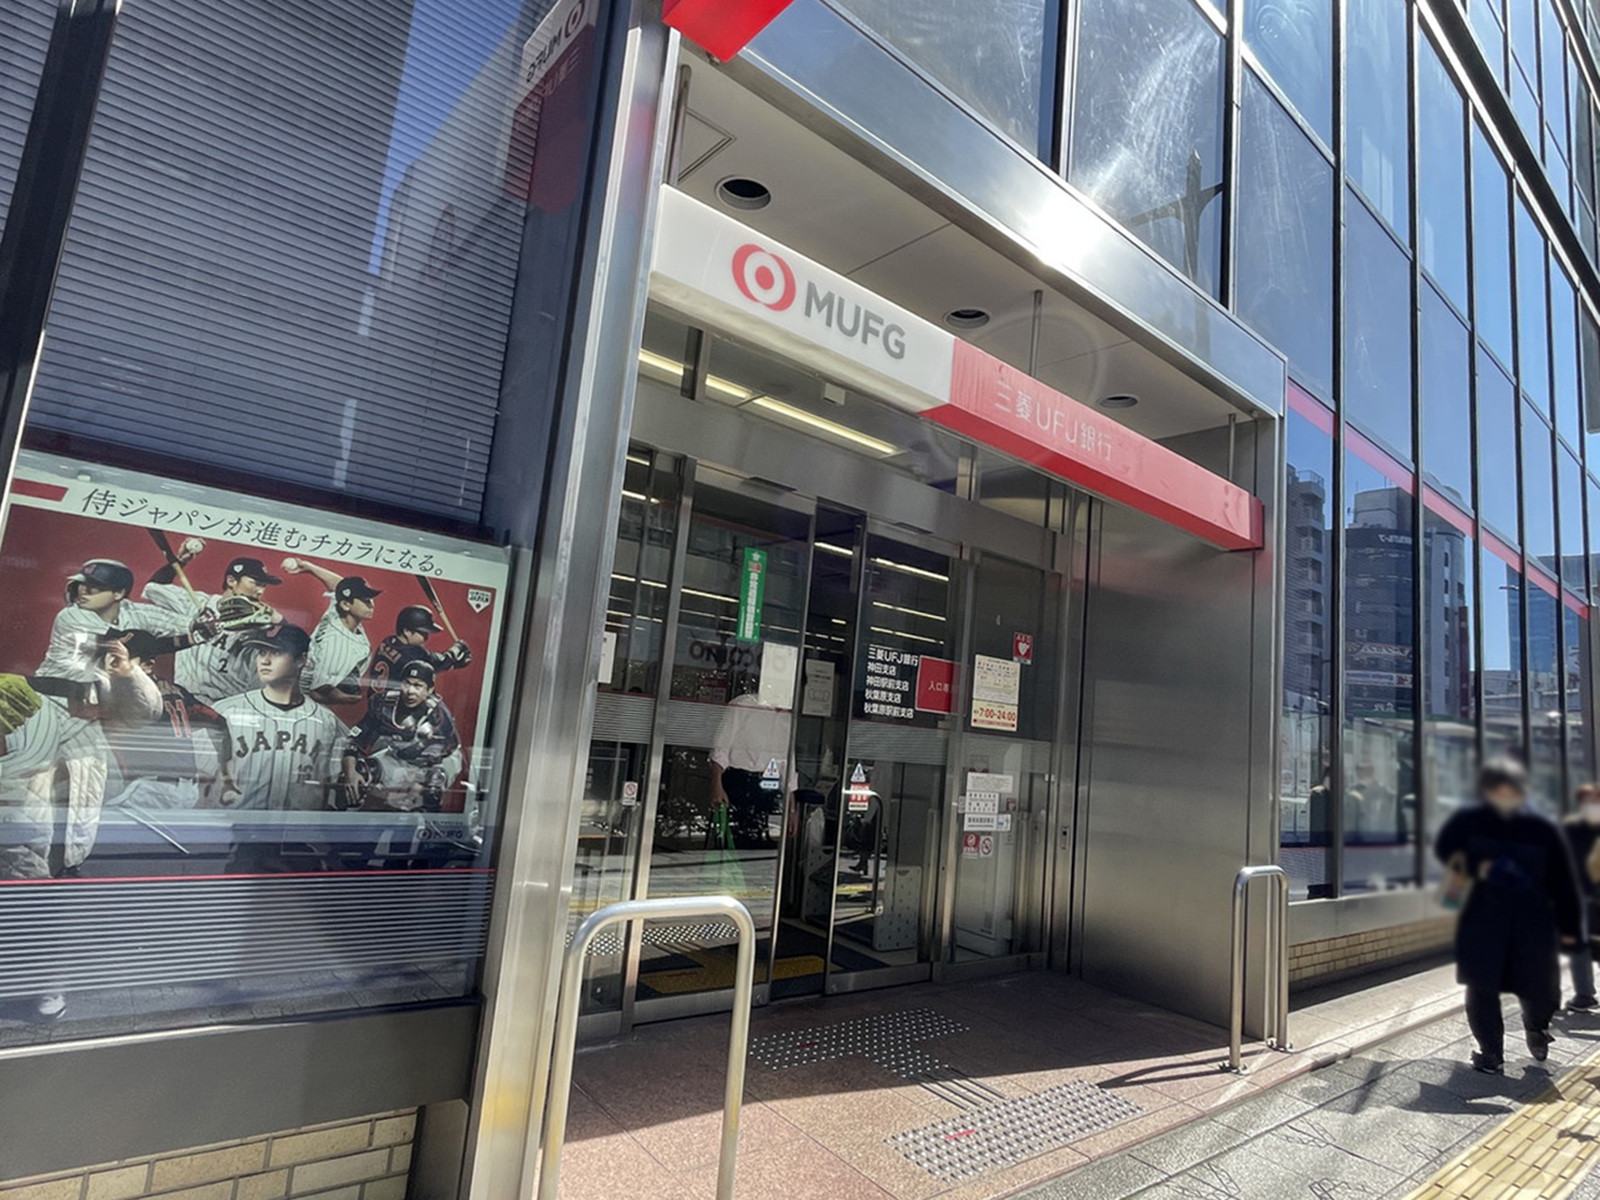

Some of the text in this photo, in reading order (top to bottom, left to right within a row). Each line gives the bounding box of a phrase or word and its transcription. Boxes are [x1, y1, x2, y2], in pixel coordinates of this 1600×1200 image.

[804, 281, 906, 360] MUFG
[994, 378, 1112, 463] 三菱UFJ銀行
[81, 487, 444, 578] 侍ジャパンが進むチカラになる。
[867, 661, 897, 676] 神田支店
[868, 647, 919, 667] 三菱UFJ銀行
[979, 707, 1016, 721] 7:00-24:00
